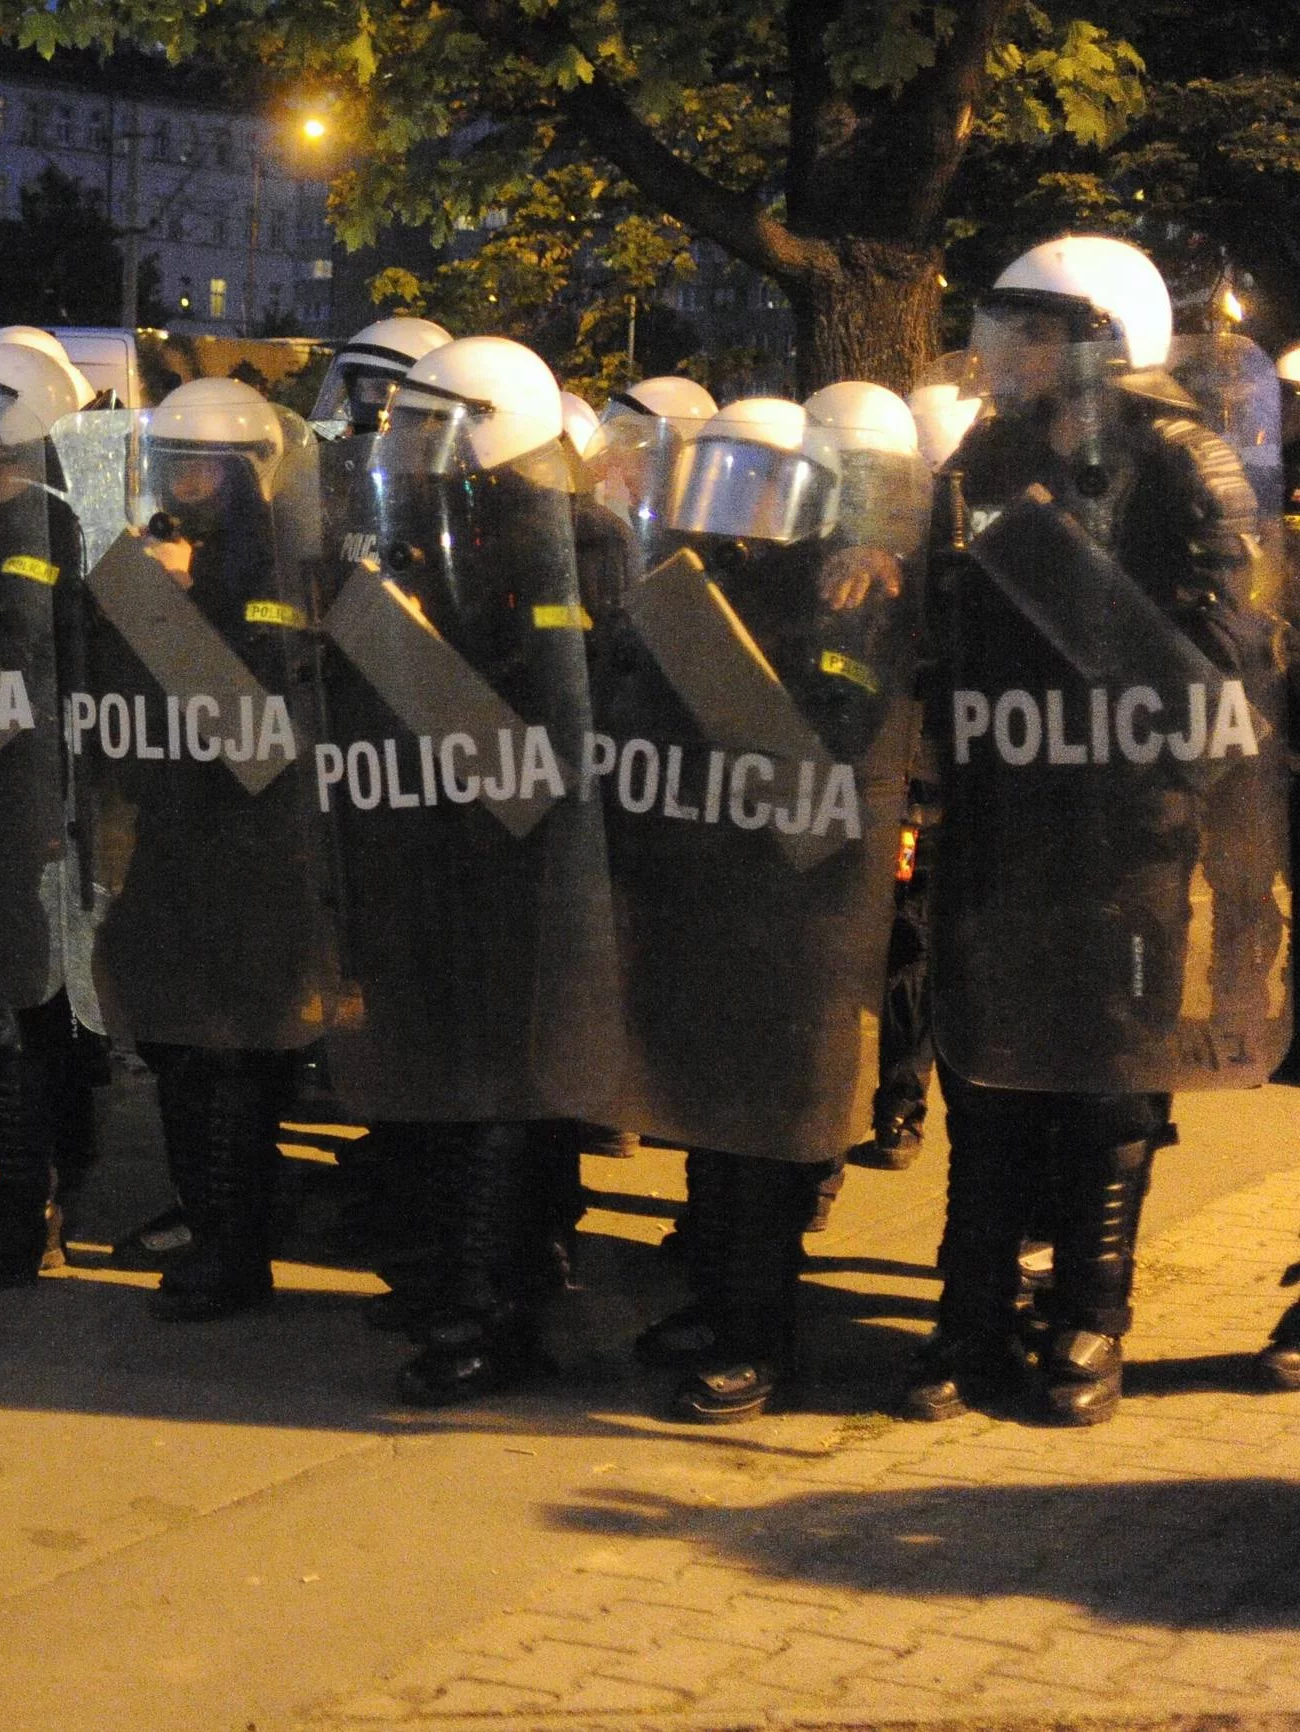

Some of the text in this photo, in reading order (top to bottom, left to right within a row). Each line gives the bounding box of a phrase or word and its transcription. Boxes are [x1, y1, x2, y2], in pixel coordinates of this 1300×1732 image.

[71, 692, 297, 762] POLICJA
[953, 680, 1260, 766] POLICJA
[315, 726, 565, 813] POLICJA
[581, 731, 862, 840] POLICJA
